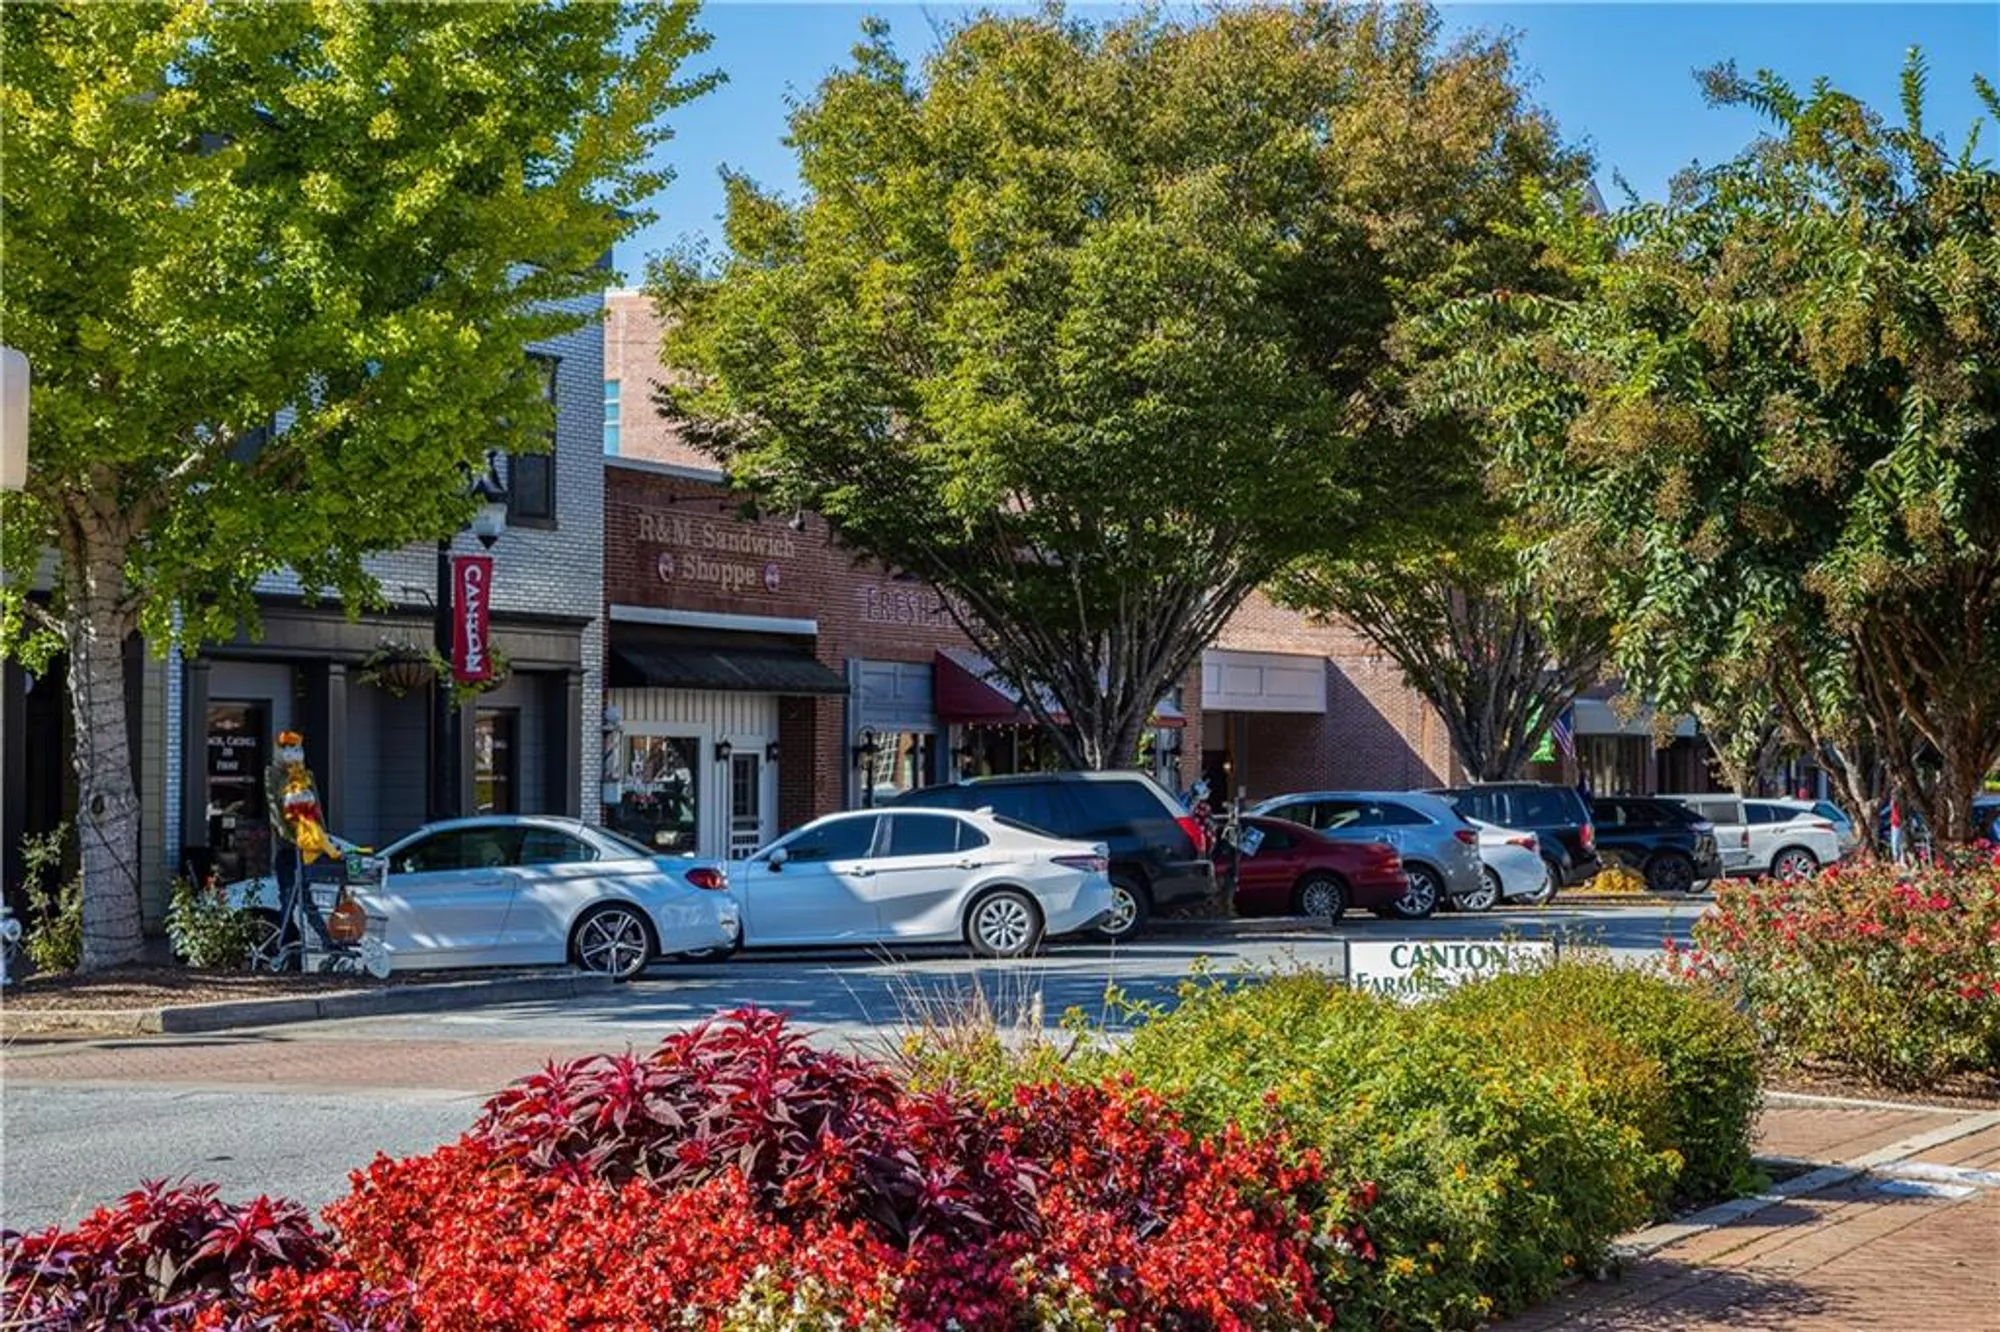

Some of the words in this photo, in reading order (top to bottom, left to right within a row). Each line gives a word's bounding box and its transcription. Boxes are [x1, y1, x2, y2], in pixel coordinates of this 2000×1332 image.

[638, 514, 691, 547] R&M
[702, 521, 794, 557] Sandwich
[682, 554, 757, 591] Shoppe
[464, 564, 482, 673] CANTON
[1390, 944, 1508, 969] CANTON
